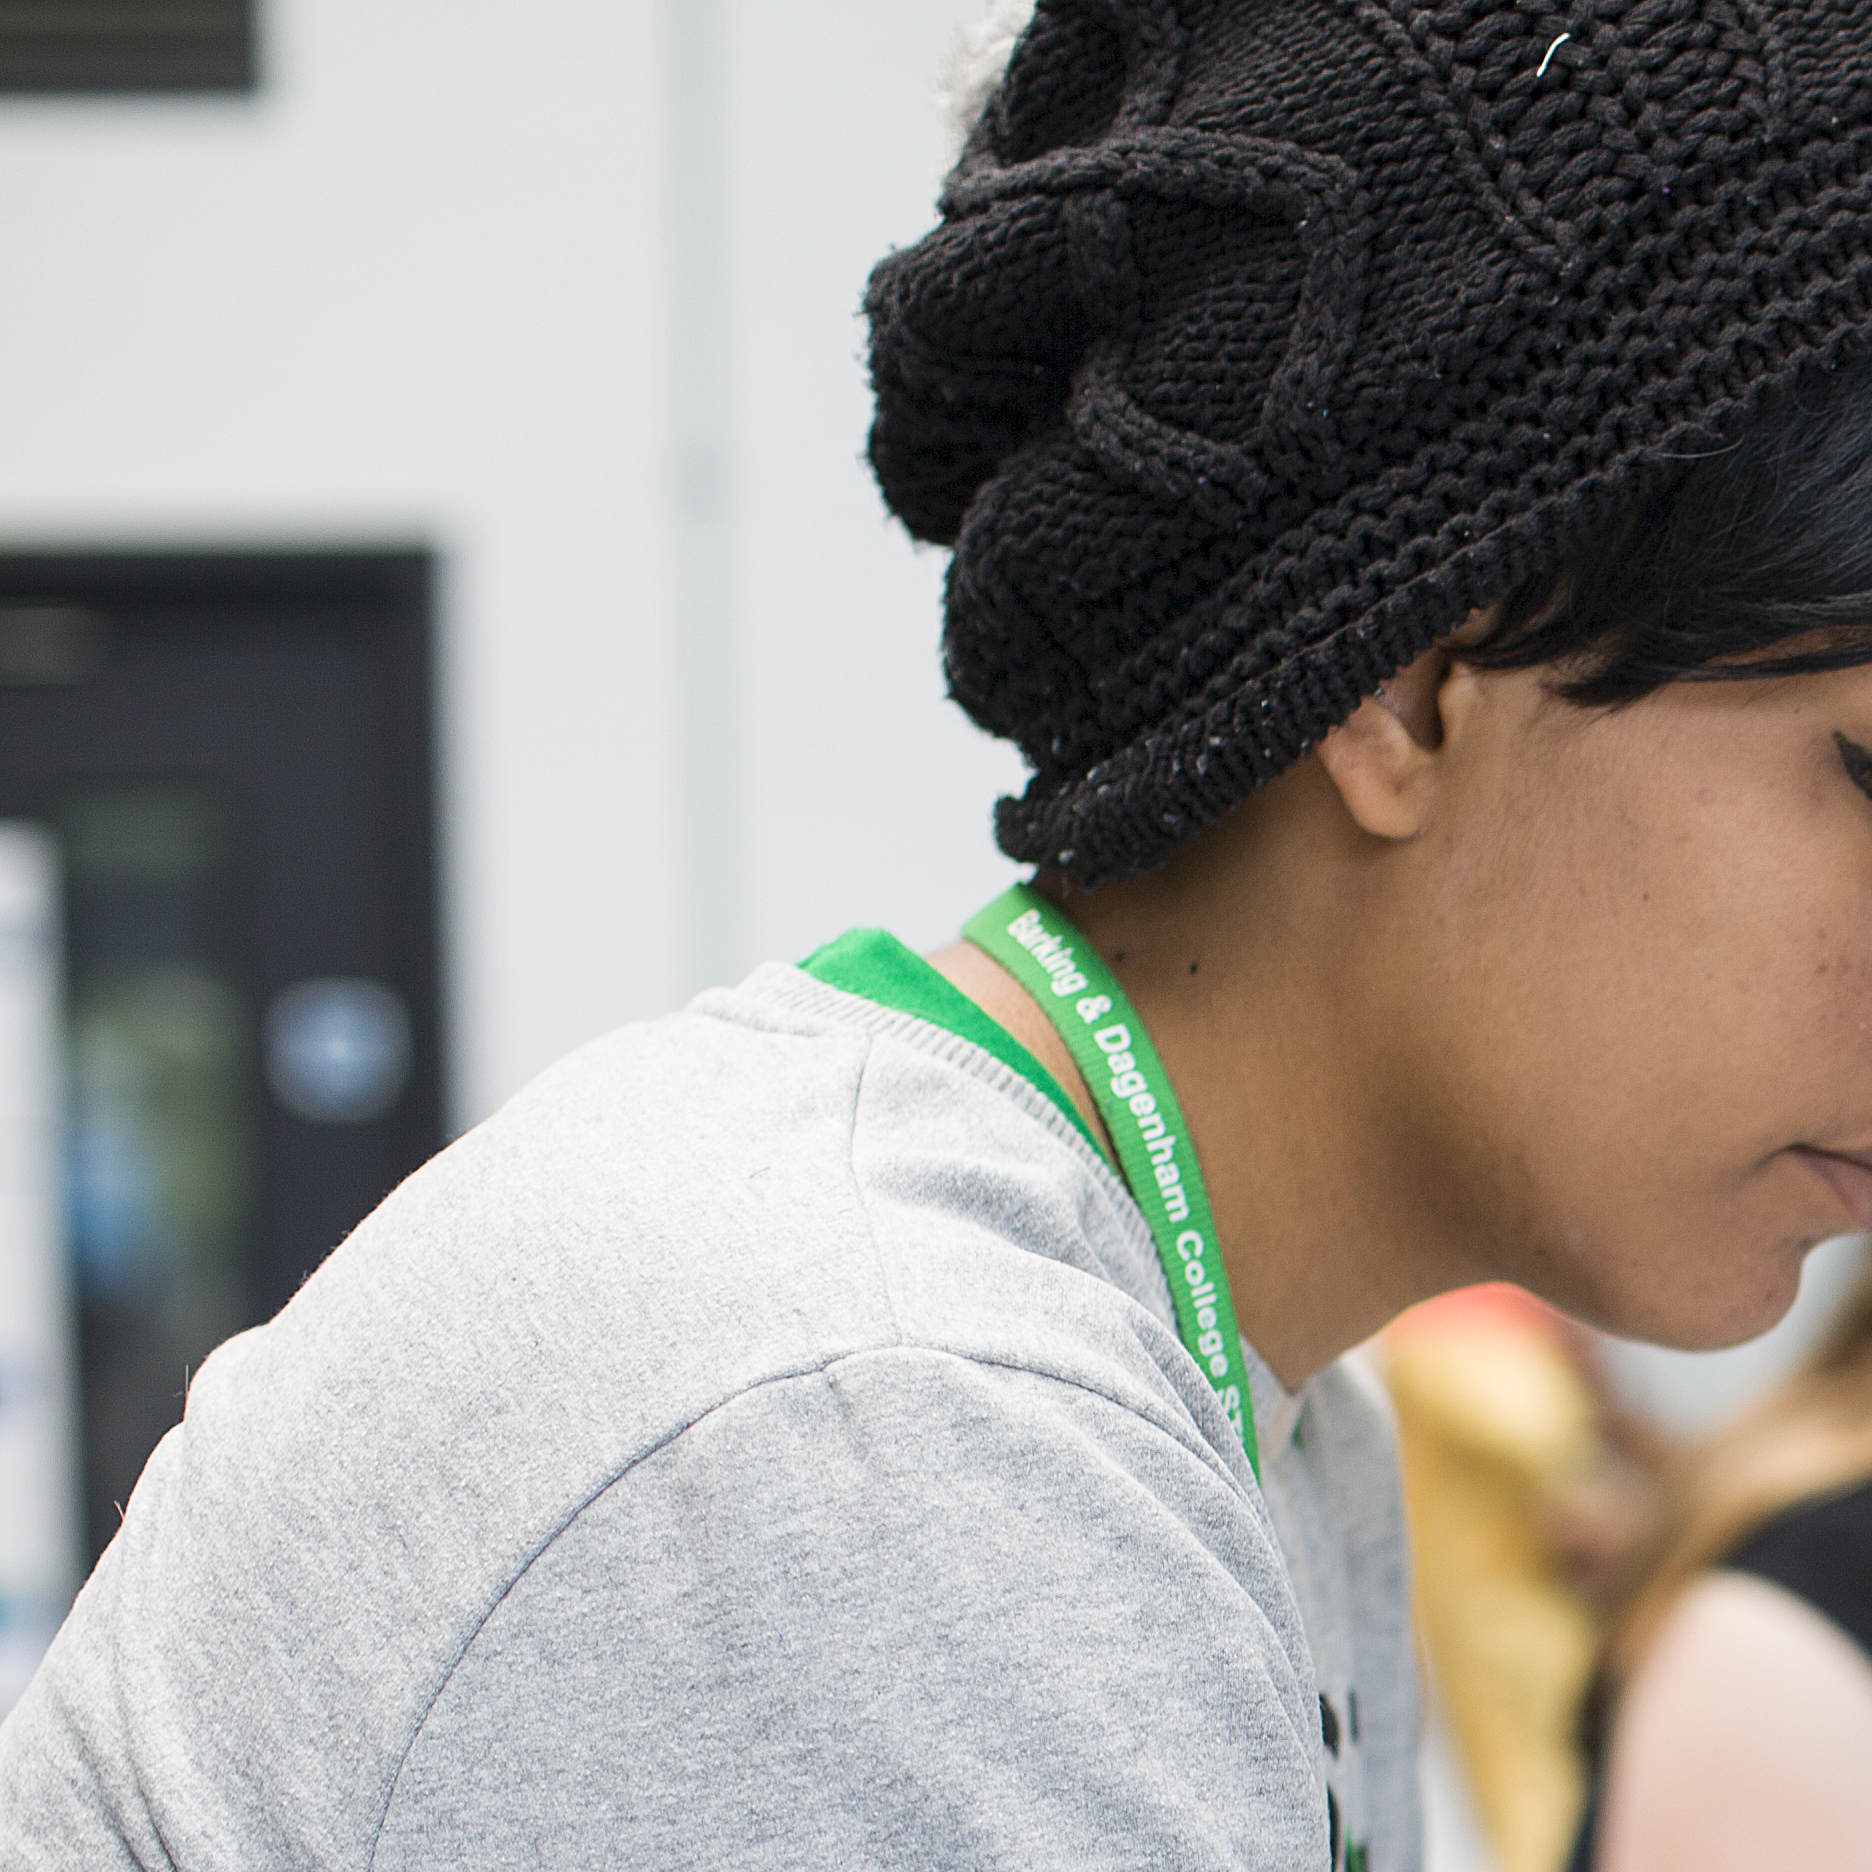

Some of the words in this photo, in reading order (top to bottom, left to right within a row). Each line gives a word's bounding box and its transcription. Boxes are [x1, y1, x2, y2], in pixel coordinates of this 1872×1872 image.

[1007, 909, 1088, 997] Barking
[1075, 995, 1112, 1024] &
[1093, 1023, 1190, 1222] Dagenham
[1176, 1230, 1229, 1378] College
